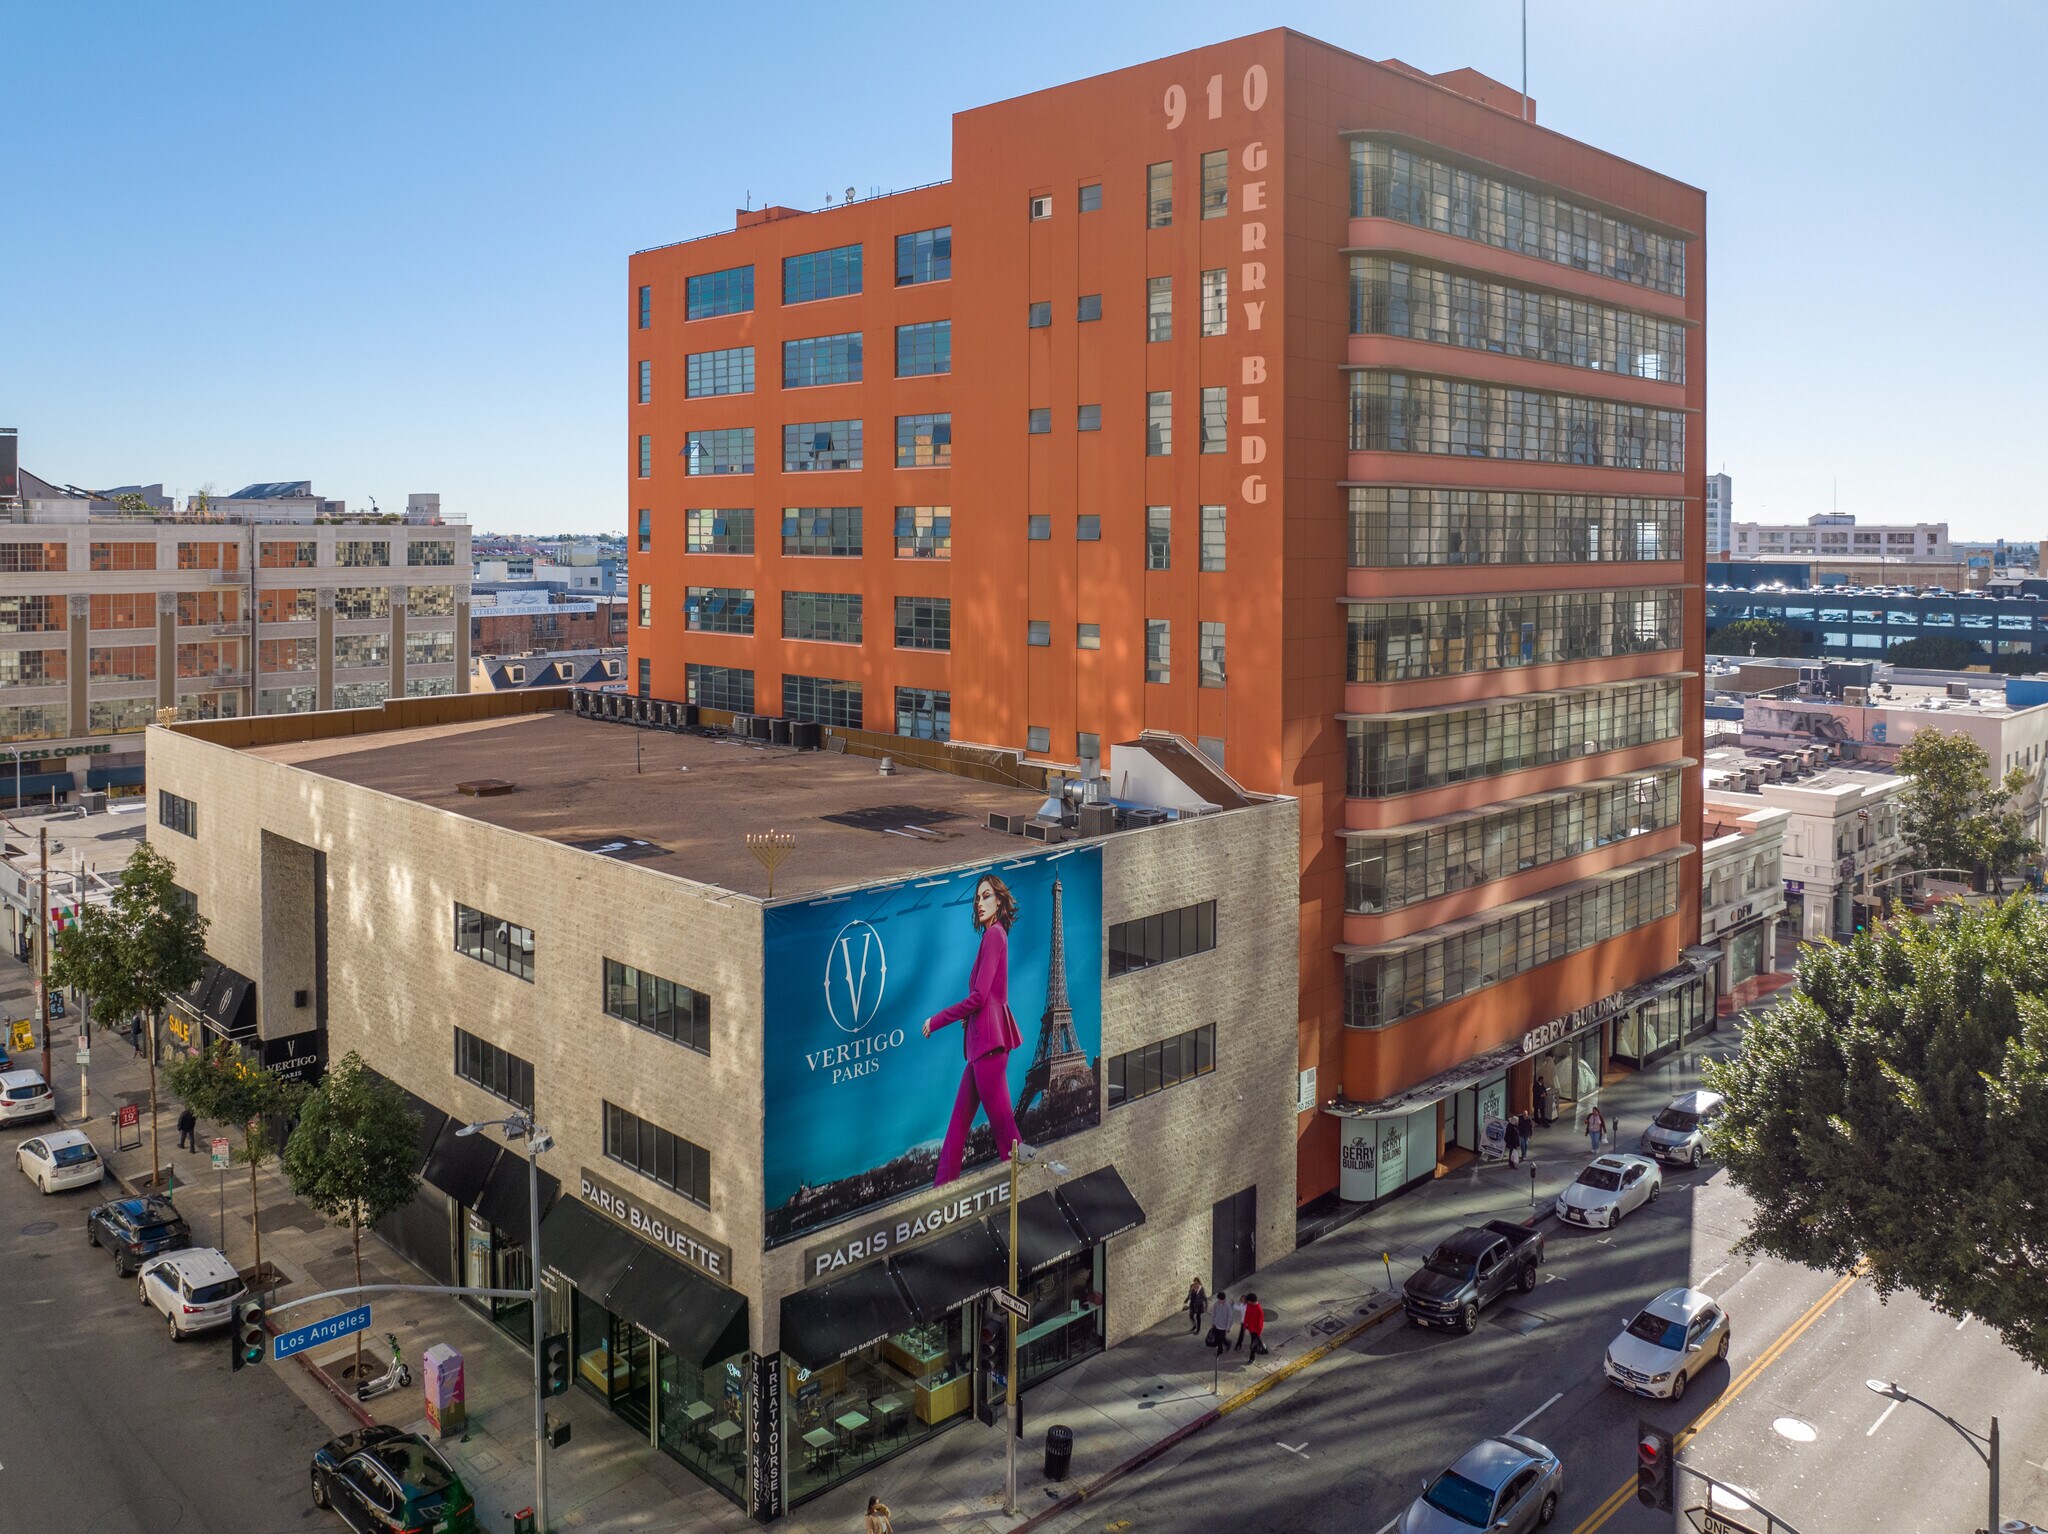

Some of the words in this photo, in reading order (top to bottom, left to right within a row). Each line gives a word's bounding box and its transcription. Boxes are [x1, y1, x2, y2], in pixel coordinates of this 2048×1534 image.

[1164, 64, 1268, 130] 910
[1242, 141, 1268, 331] GERRY
[1241, 355, 1267, 504] BLDG
[506, 606, 516, 614] IN
[517, 605, 549, 614] FABRICS
[54, 744, 111, 758] COFFEE
[169, 1014, 190, 1043] SALE
[1523, 1015, 1568, 1053] GERRY
[1571, 990, 1624, 1032] BUILDING
[805, 1028, 905, 1071] VERTIGO
[265, 1055, 317, 1072] VERTIGO
[281, 1070, 302, 1079] PARIS
[832, 1058, 880, 1085] PARIS
[1342, 1146, 1375, 1160] GERRY
[1352, 1136, 1367, 1147] The
[1382, 1133, 1402, 1154] GERRY
[1343, 1159, 1374, 1170] BUILDING
[581, 1178, 626, 1220] PARIS
[630, 1206, 721, 1276] BAGUETTE
[815, 1230, 888, 1276] PARIS
[895, 1181, 1011, 1245] BAGUETTE
[946, 1299, 962, 1312] PARIS
[962, 1287, 990, 1304] BAGUETTE
[1001, 1294, 1012, 1306] ONE
[1013, 1302, 1025, 1313] WAY
[280, 1334, 305, 1351] Los
[311, 1312, 366, 1341] Angeles
[840, 1346, 858, 1359] PARIS
[858, 1332, 889, 1351] BAGUETTE
[1704, 1517, 1731, 1534] ONE
